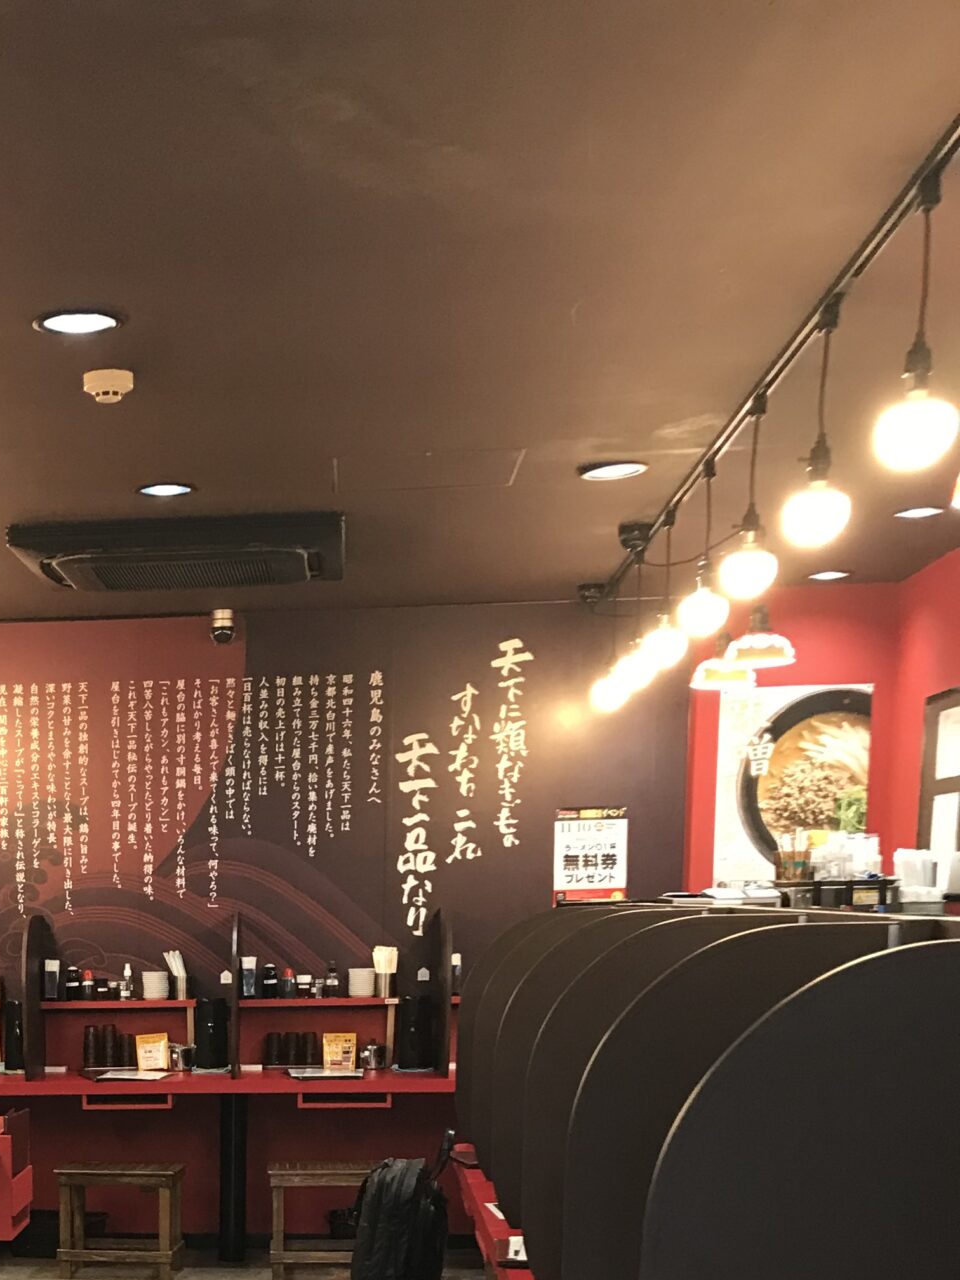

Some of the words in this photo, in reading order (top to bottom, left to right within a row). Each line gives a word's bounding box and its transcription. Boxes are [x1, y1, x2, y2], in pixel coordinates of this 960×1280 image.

[191, 678, 203, 790] そればかり考える毎日。
[224, 677, 237, 820] 黙々と麺をさばく頭の中では
[241, 677, 253, 835] 一日百杯は売らなければならない。
[257, 676, 270, 796] 人並みの収入を得るには
[274, 676, 287, 787] 初日の売上げは十一杯。
[324, 674, 337, 839] 京都北白川で産声をあげました。
[341, 673, 354, 832] 昭和四十六年、私たち天下一品は
[366, 670, 384, 804] 鹿児島のみなさんへ
[490, 638, 534, 848] 天下に類なきもの
[394, 732, 440, 937] 天下一品なり
[563, 853, 617, 871] 無料券
[565, 872, 615, 884] プレゼント
